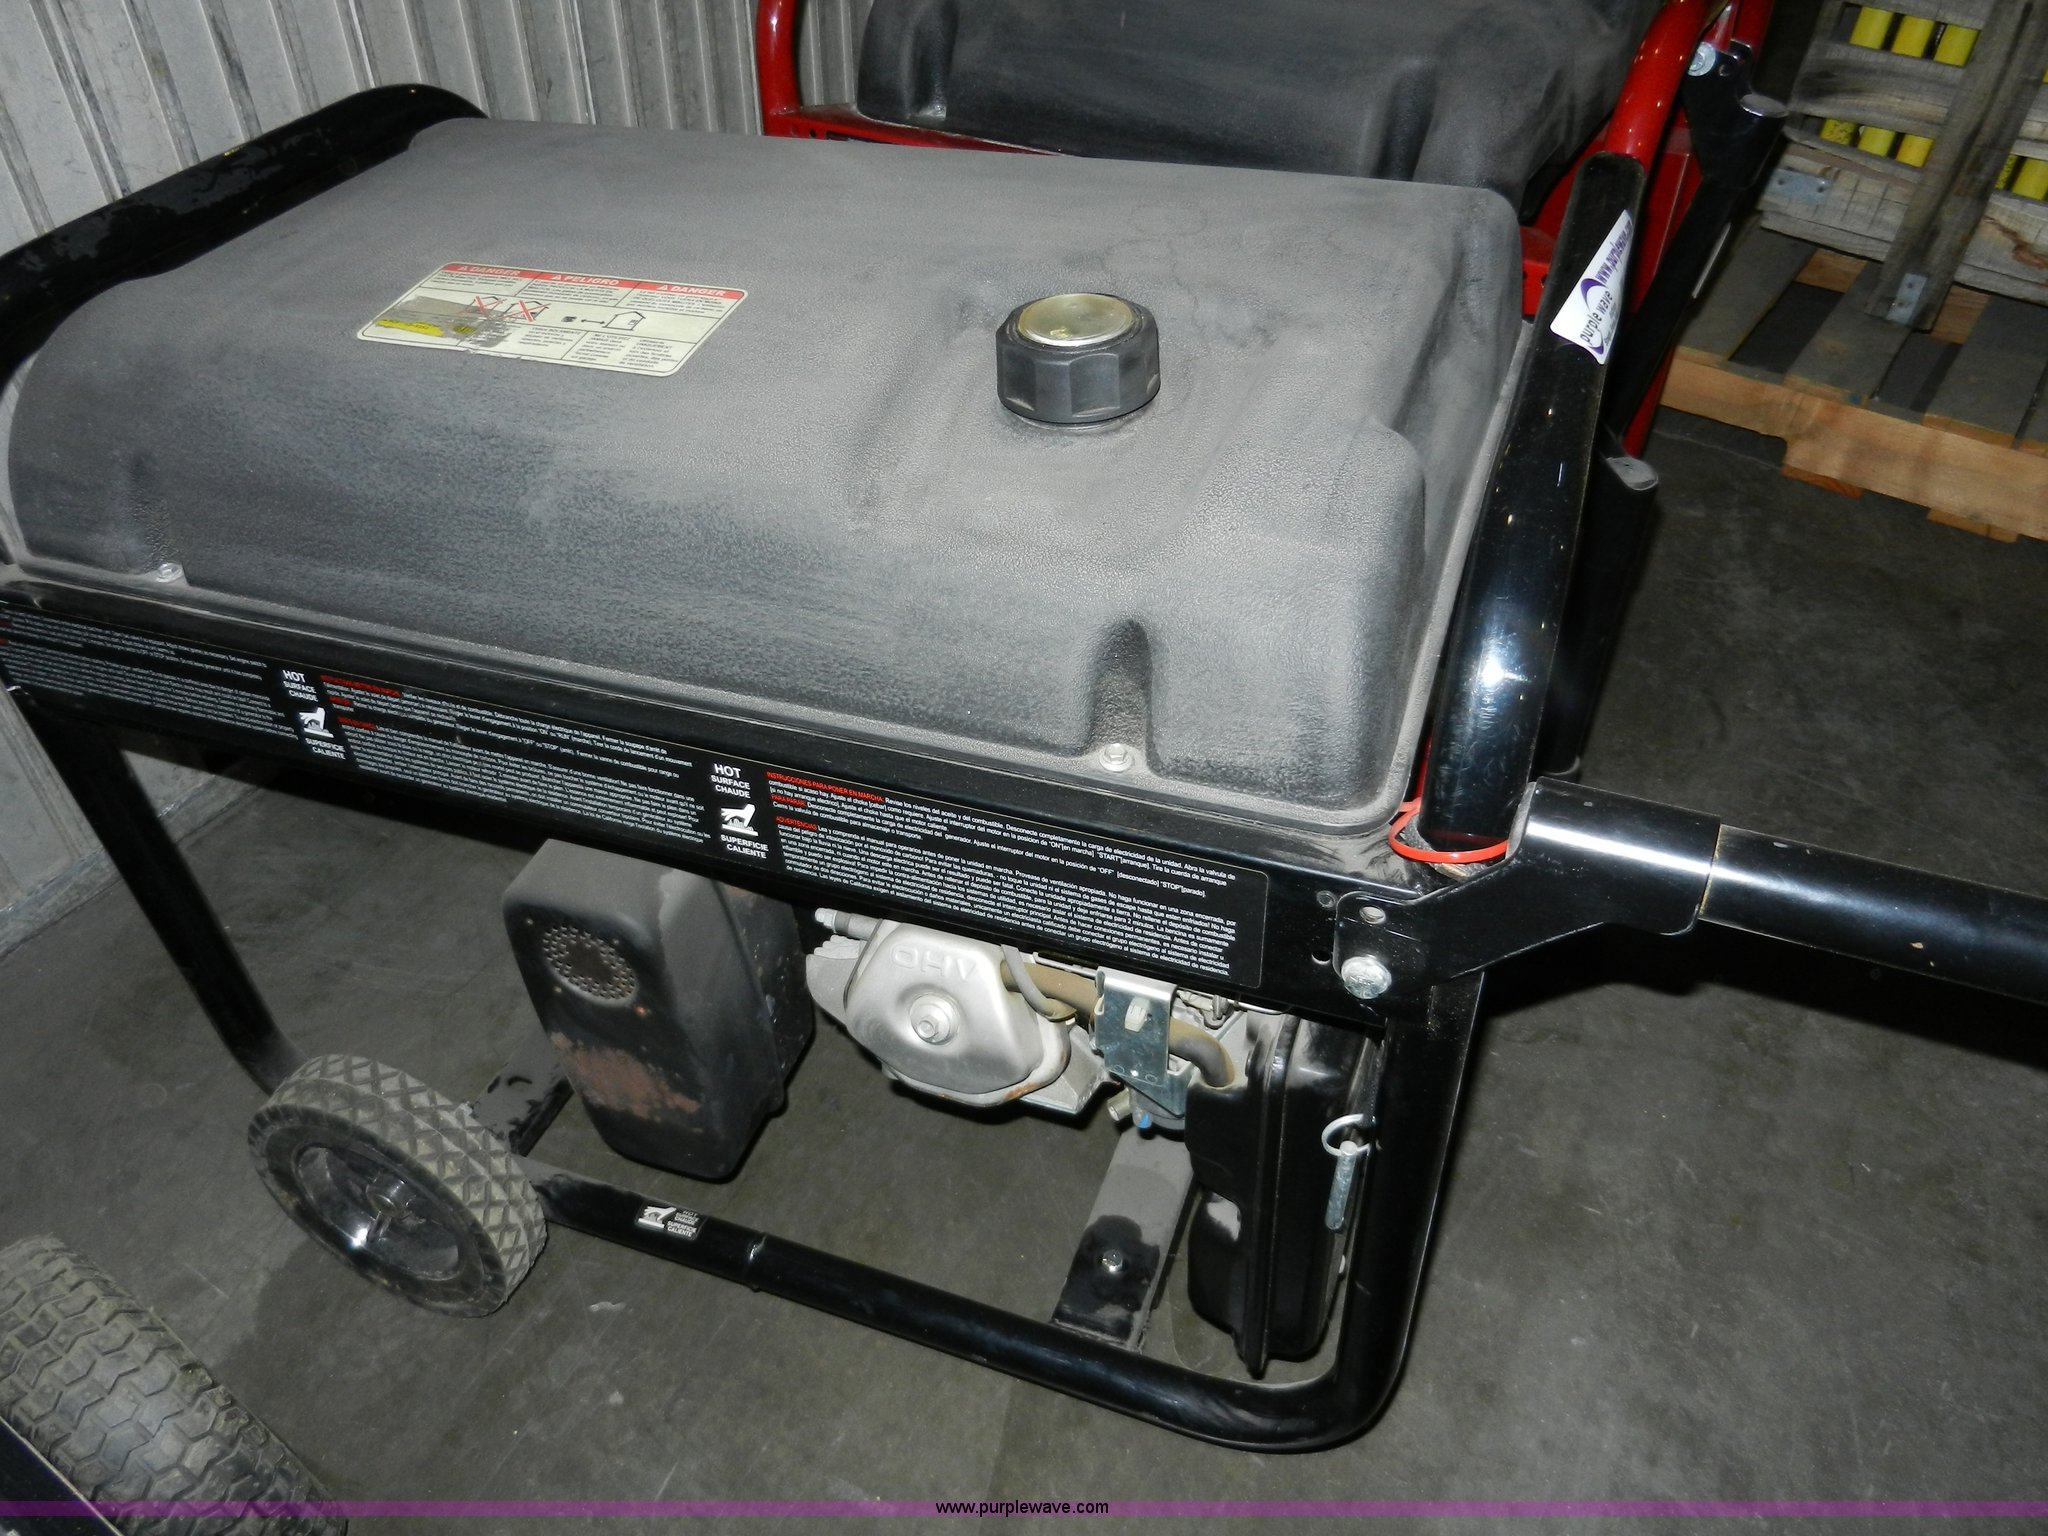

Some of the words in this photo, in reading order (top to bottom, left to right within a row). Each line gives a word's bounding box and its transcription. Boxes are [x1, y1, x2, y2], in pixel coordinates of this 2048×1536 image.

[469, 266, 521, 276] DANGER
[564, 275, 620, 286] PELIGRO
[669, 285, 727, 297] DANGER
[1580, 312, 1603, 346] purple
[1600, 290, 1614, 315] wave
[282, 669, 306, 683] HOT
[713, 763, 741, 779] HOT
[710, 774, 751, 790] SURFACE
[715, 784, 751, 799] CHAUDE
[720, 834, 769, 852] SUPERFICIE
[726, 843, 767, 859] CALIENTE
